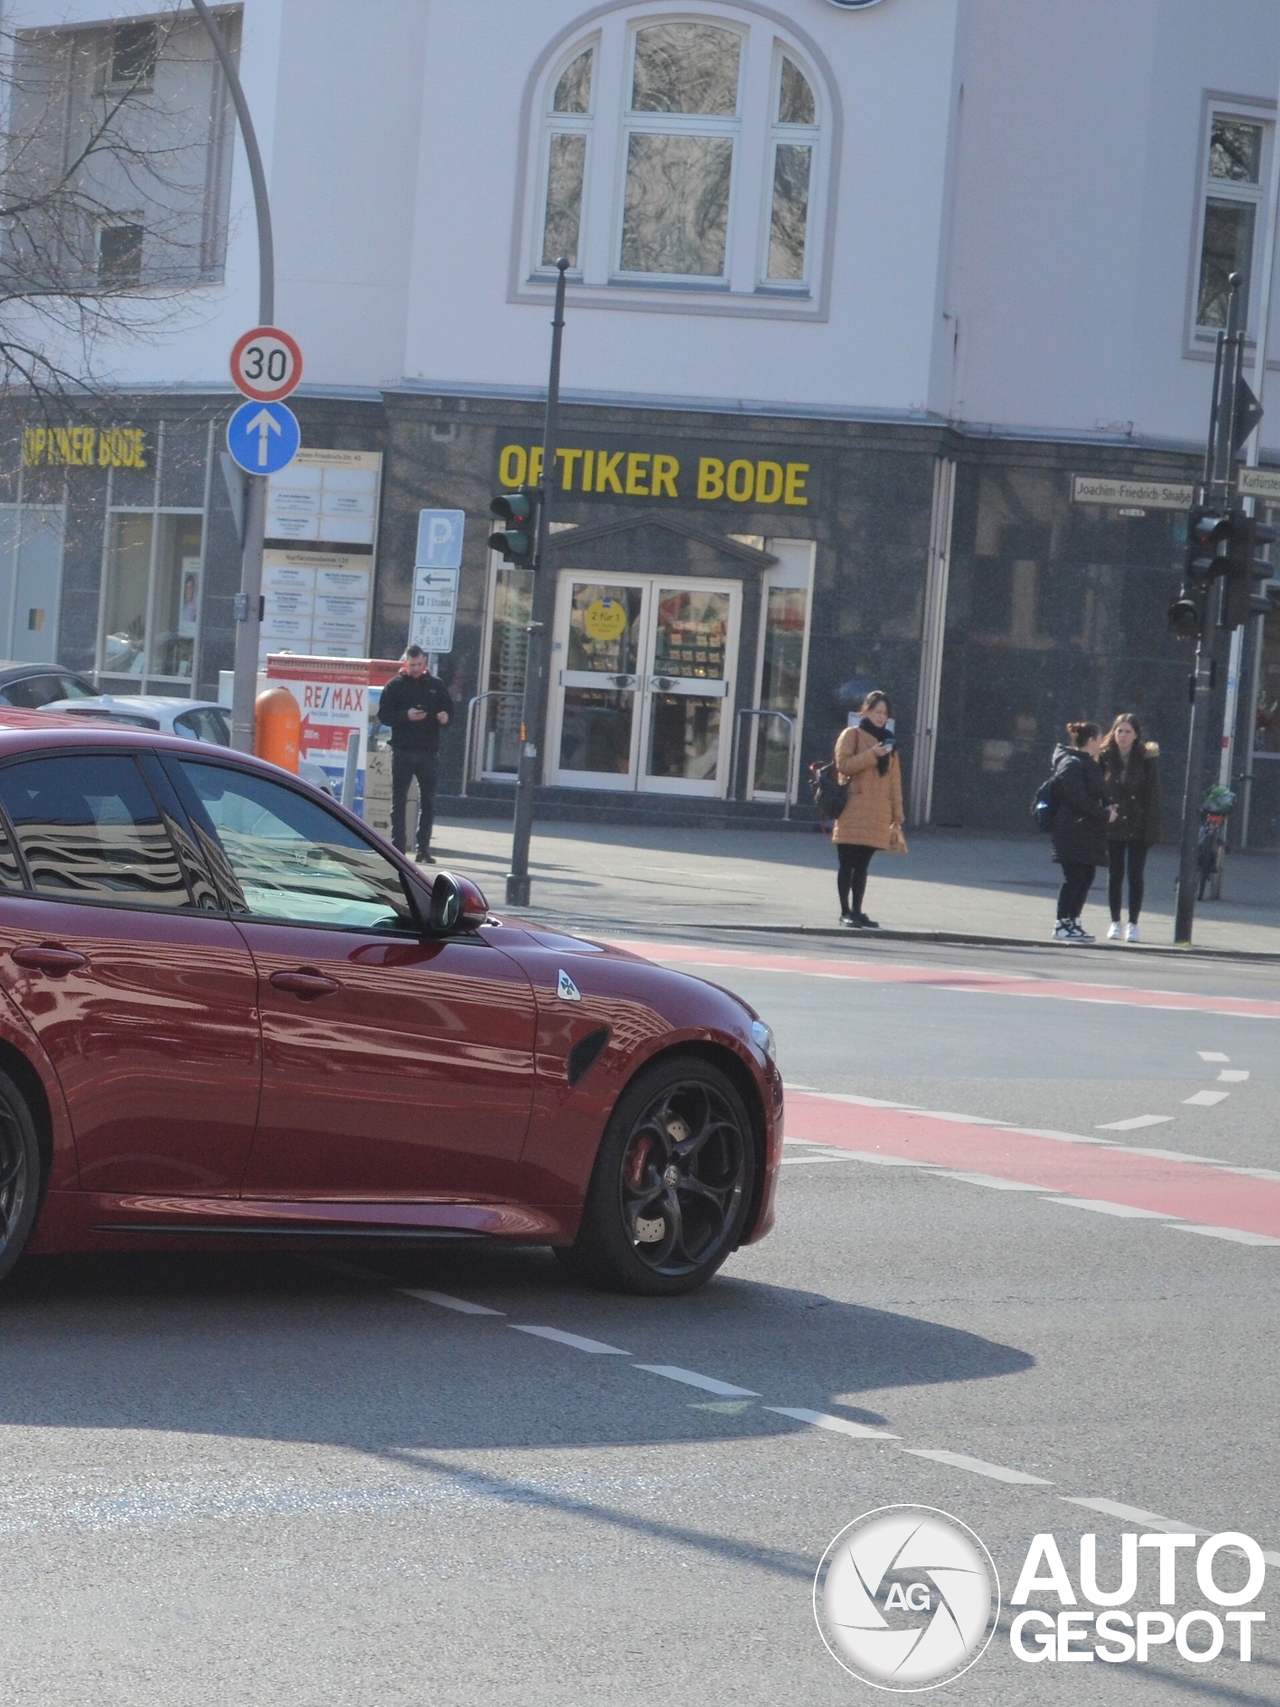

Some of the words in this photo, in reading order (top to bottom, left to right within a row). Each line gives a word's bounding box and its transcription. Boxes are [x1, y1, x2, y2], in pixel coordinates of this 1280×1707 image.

[245, 346, 287, 382] 30
[99, 428, 147, 468] BODE
[498, 445, 680, 498] OPTIKER
[697, 456, 810, 506] BODE
[1077, 482, 1192, 504] Joachim-Friedrich-Straße
[592, 611, 598, 621] 2
[600, 611, 613, 621] für
